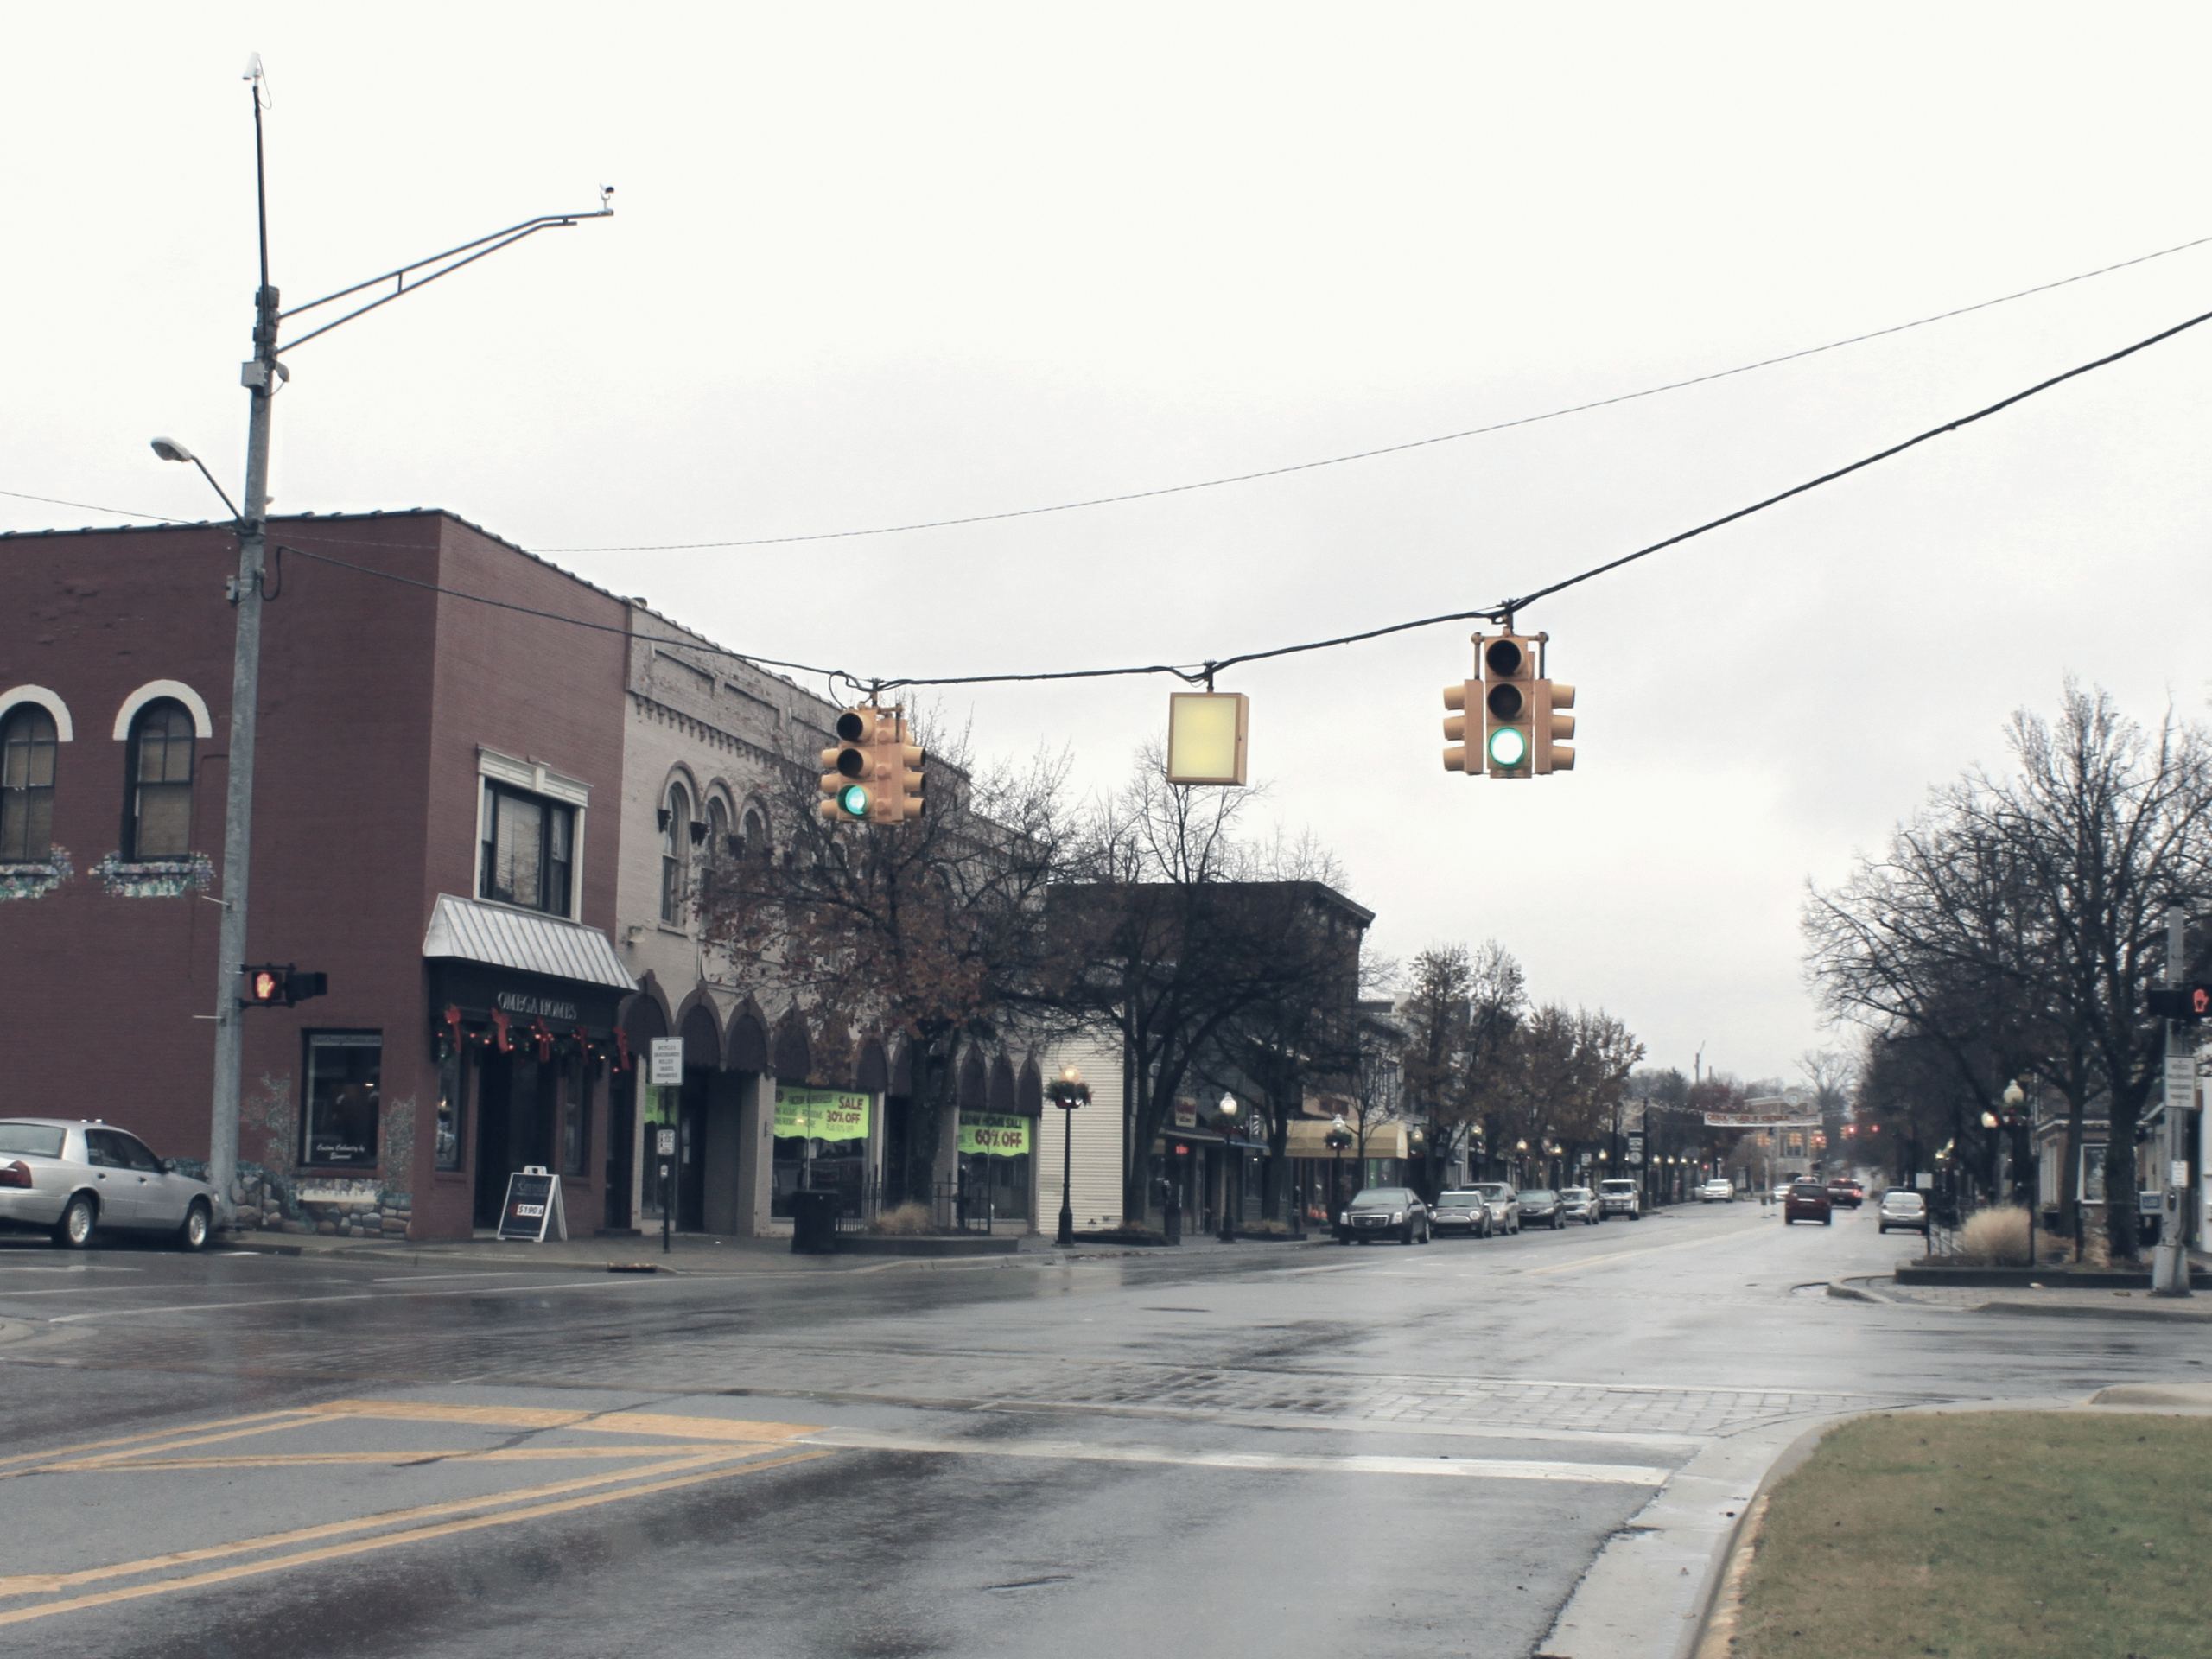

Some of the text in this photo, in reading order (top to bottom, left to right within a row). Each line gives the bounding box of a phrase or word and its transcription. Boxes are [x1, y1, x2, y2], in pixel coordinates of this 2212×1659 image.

[498, 992, 577, 1020] OMEGA HOMES
[840, 1096, 863, 1110] SALE
[827, 1111, 844, 1123] 30%
[846, 1113, 861, 1123] OFF
[975, 1129, 1000, 1147] 60%
[1002, 1132, 1022, 1148] OFF
